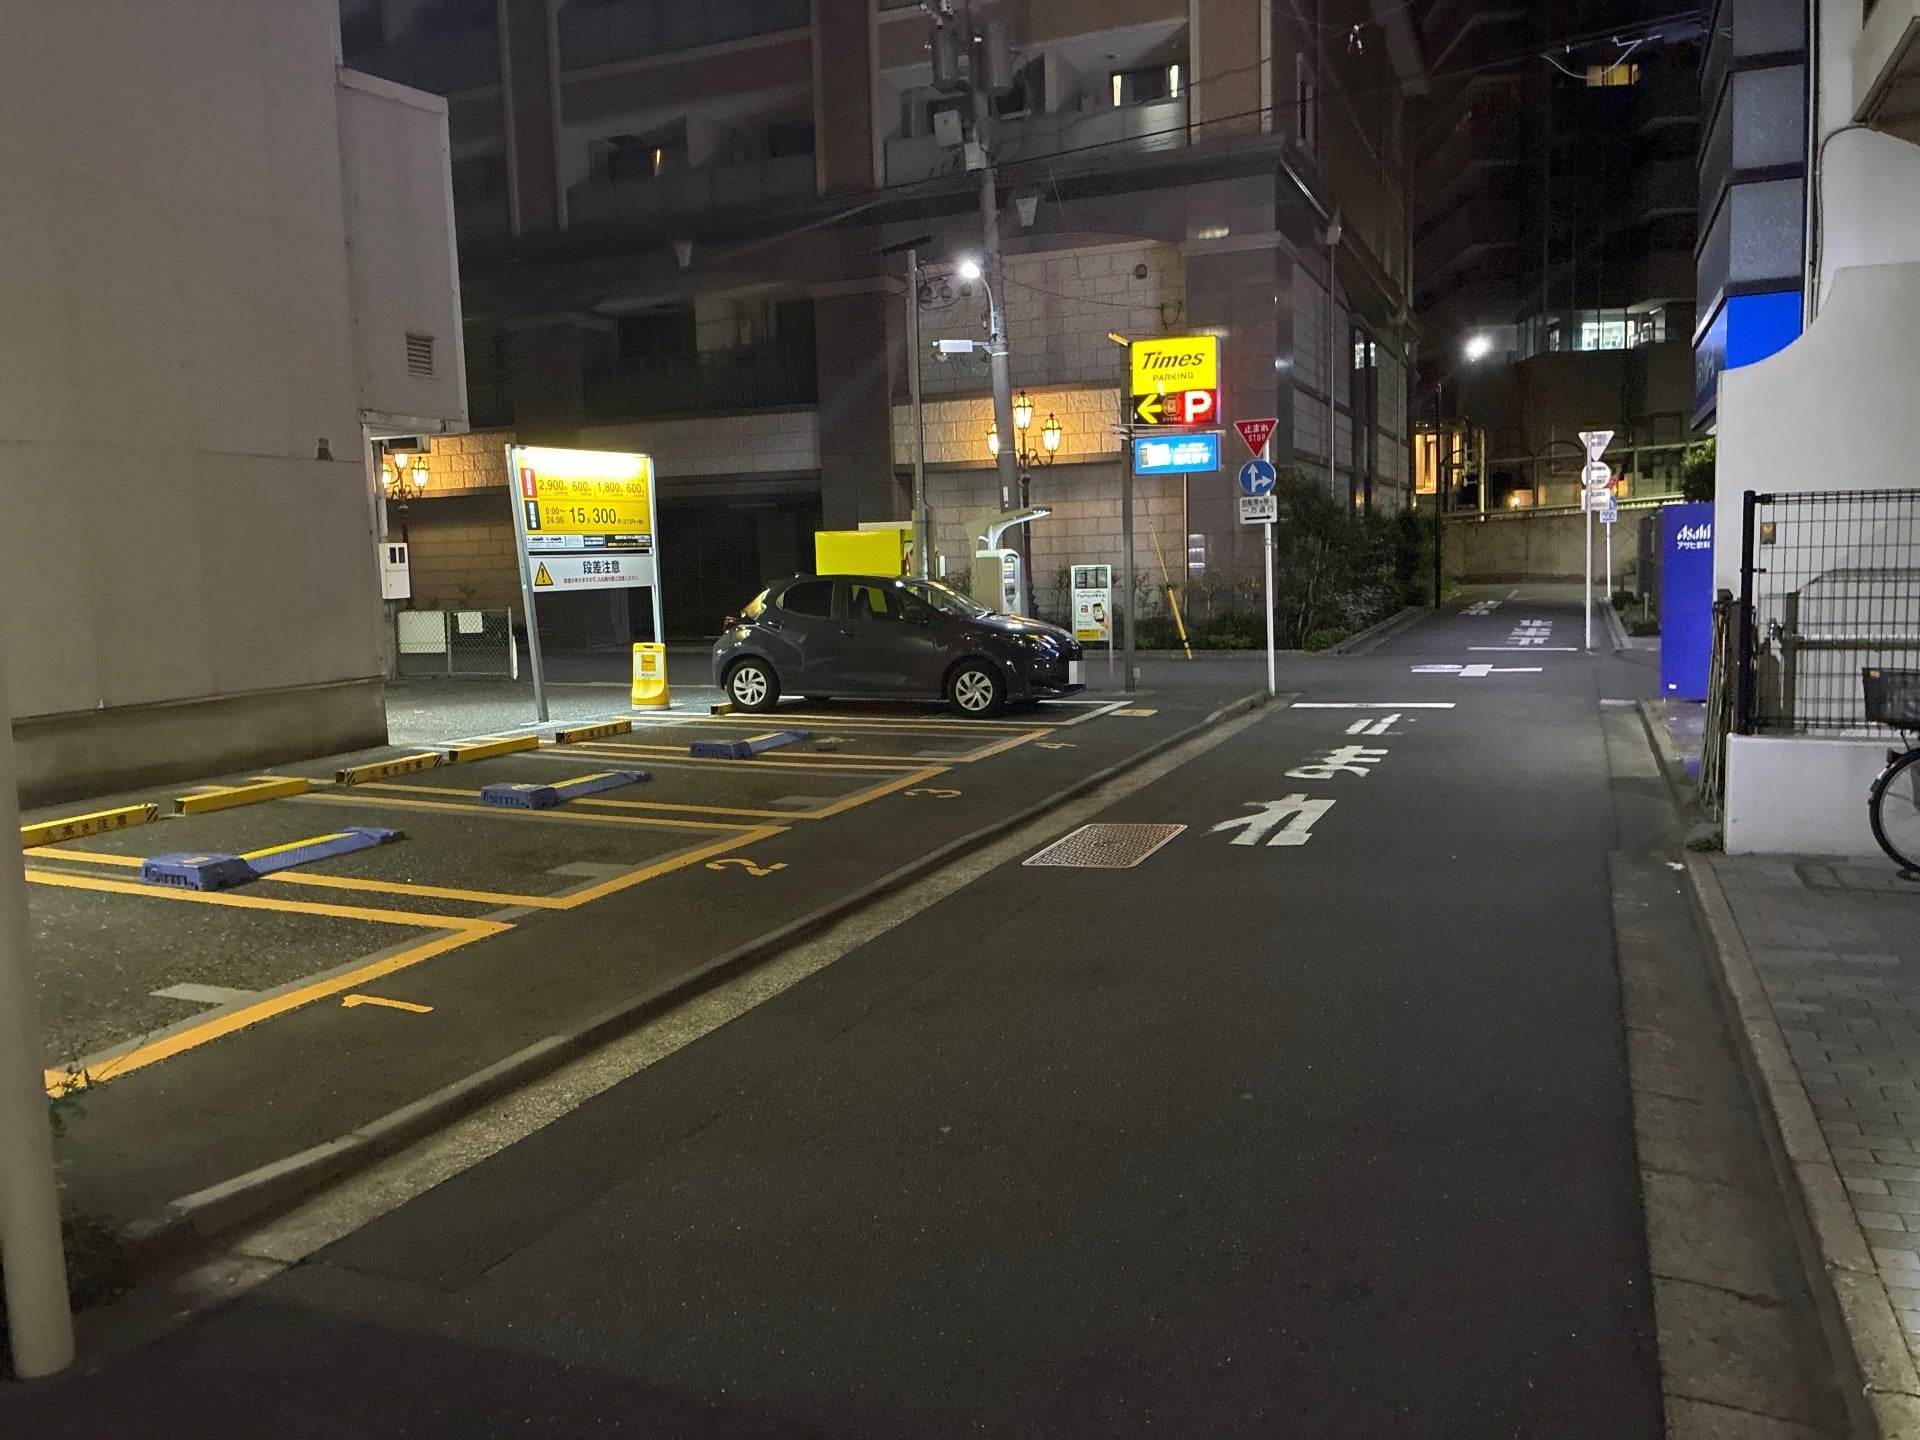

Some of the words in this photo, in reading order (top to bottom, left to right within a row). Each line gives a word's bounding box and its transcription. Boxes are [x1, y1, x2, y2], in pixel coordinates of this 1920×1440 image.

[1142, 350, 1205, 370] Times
[1152, 371, 1194, 382] PARKING
[1184, 390, 1212, 423] P
[1243, 423, 1269, 434] 止まれ
[1248, 433, 1266, 442] STOP
[1676, 523, 1711, 541] Asahi
[1676, 541, 1711, 550] アサヒ飲料
[582, 560, 621, 575] 段差注意
[705, 858, 789, 877] 2
[340, 993, 435, 1014] 1
